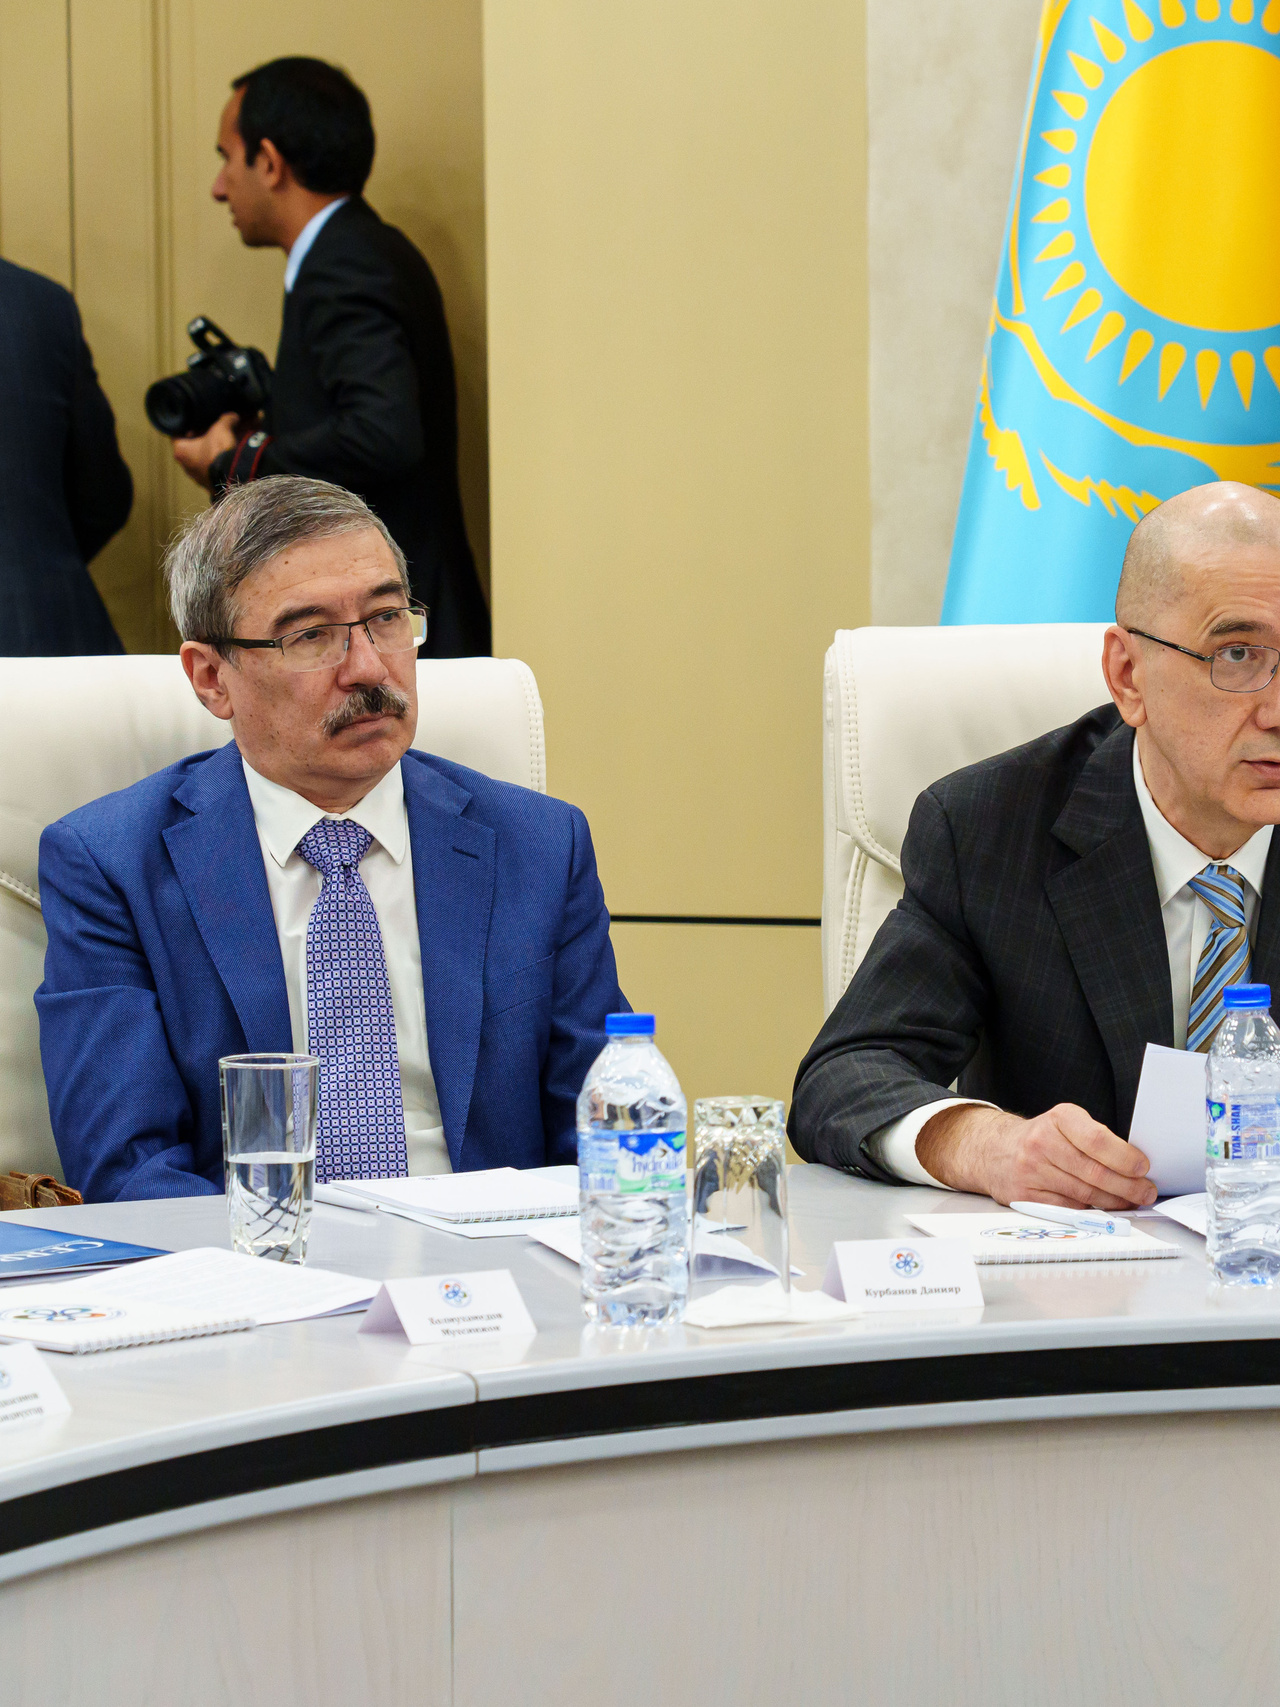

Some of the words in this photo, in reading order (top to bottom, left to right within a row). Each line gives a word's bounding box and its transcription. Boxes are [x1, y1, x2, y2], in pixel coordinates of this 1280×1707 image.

[1231, 1104, 1242, 1159] TYAN-SHAN
[864, 1288, 918, 1298] Курбанов
[920, 1286, 961, 1296] Данияр
